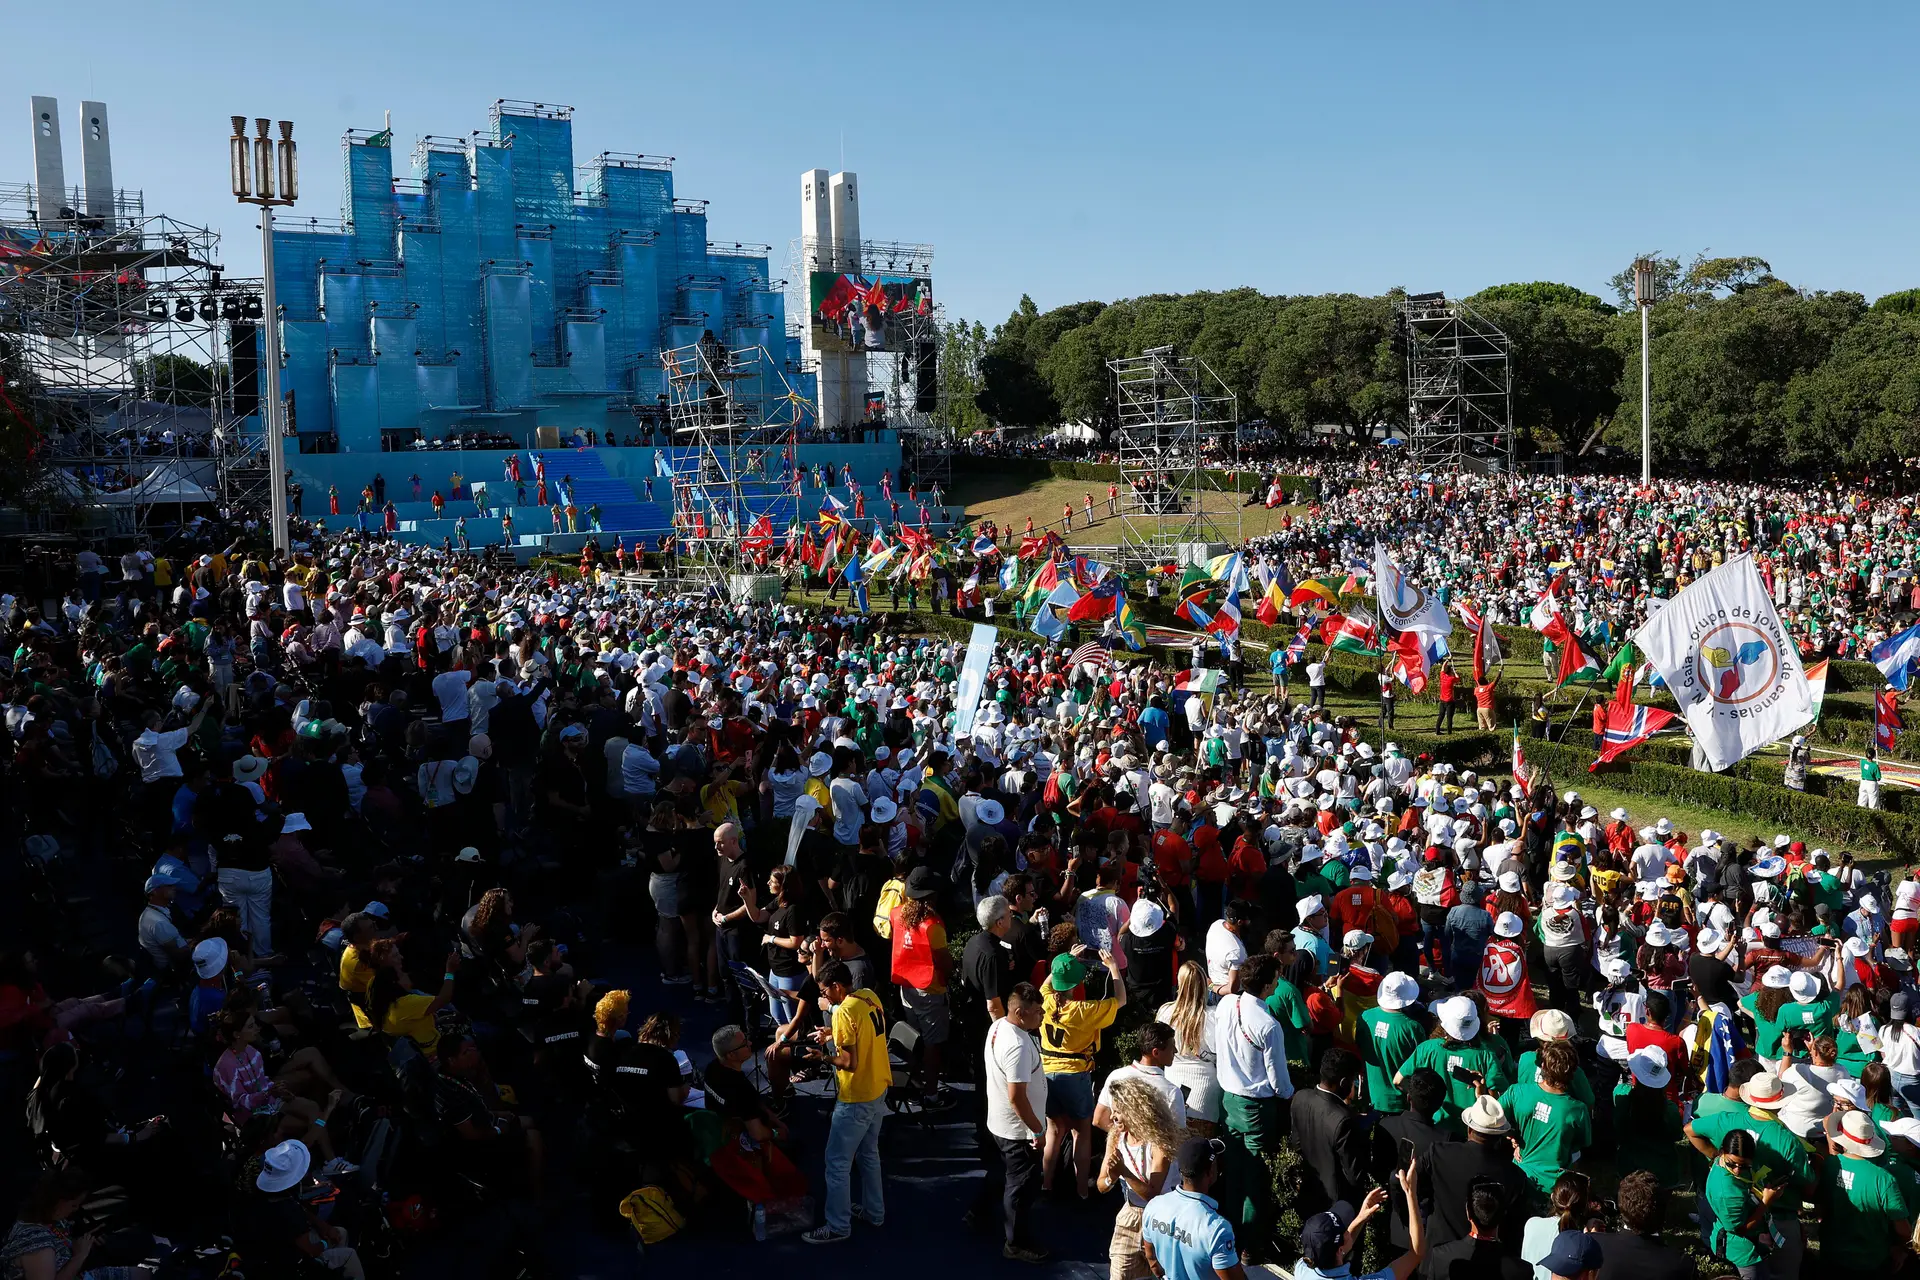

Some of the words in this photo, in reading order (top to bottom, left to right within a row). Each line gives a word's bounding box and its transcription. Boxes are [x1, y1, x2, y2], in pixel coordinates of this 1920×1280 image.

[1731, 606, 1751, 618] de
[1752, 611, 1789, 656] jovens
[1682, 656, 1694, 687] Gaia
[1781, 662, 1793, 680] de
[1730, 684, 1785, 719] canelas
[1592, 874, 1607, 886] GIC
[1045, 1023, 1065, 1047] V
